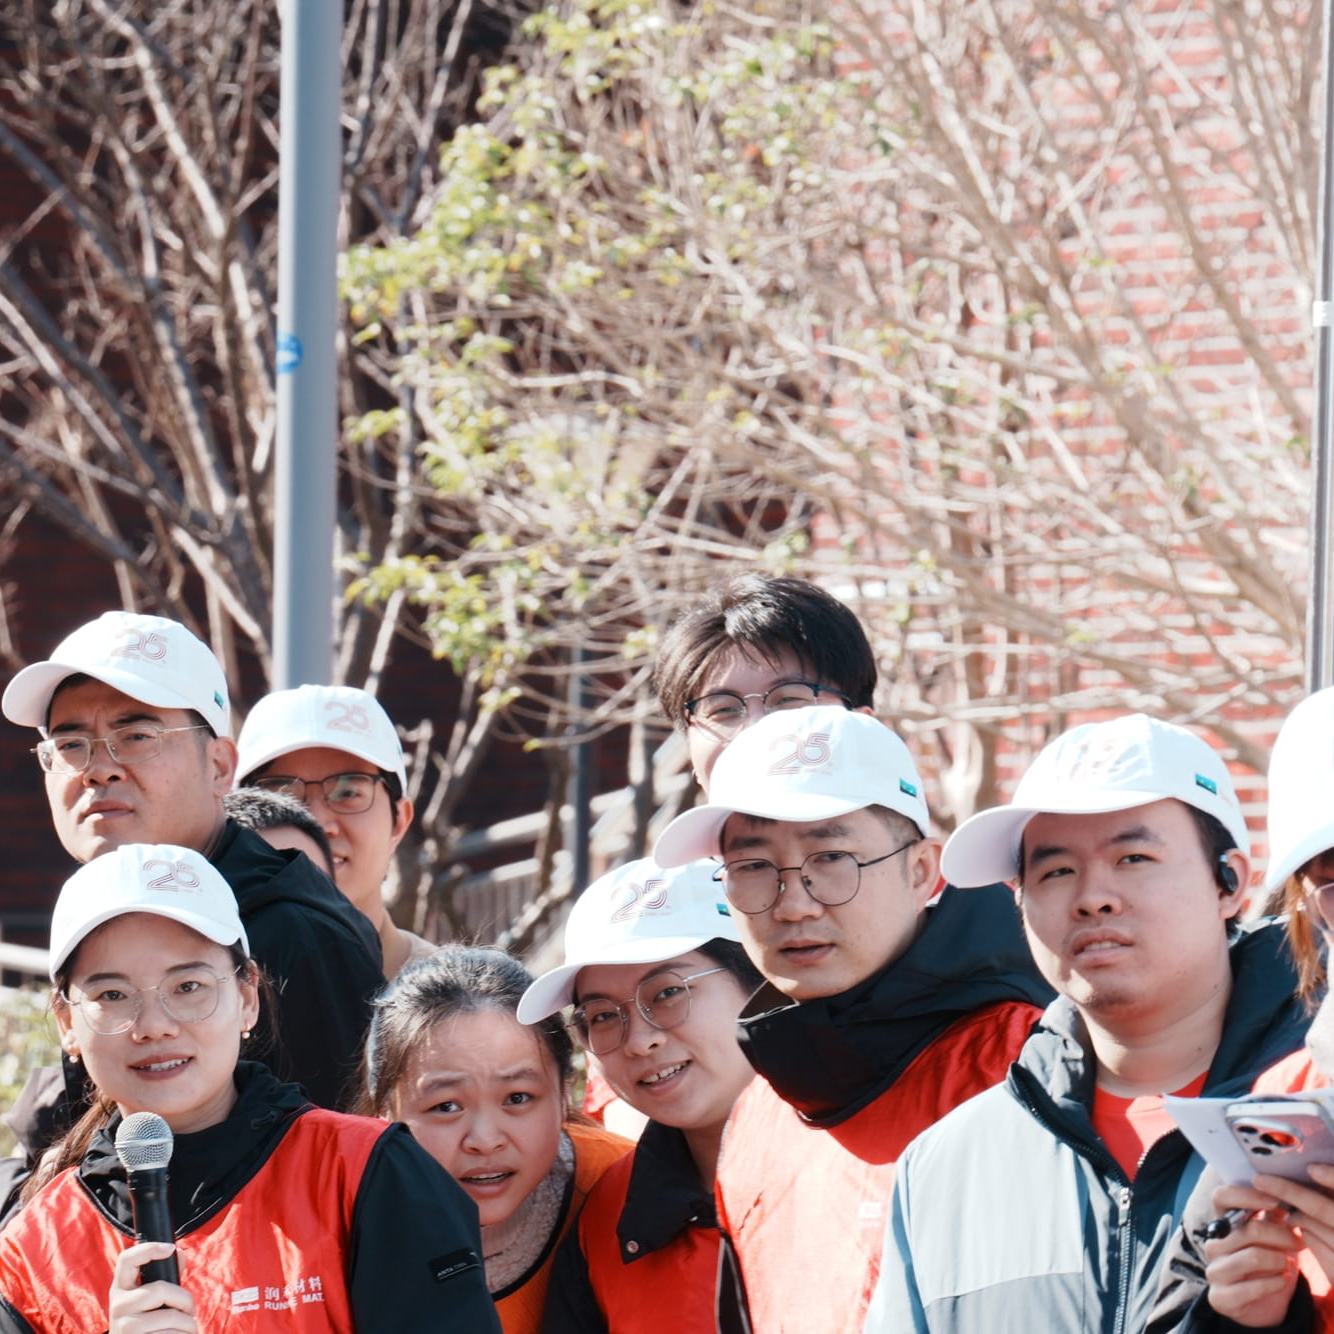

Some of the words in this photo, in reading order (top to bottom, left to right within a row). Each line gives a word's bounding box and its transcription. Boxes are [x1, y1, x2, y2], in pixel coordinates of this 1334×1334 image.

[768, 733, 830, 776] 25
[143, 859, 200, 892] 25
[610, 879, 668, 924] 25
